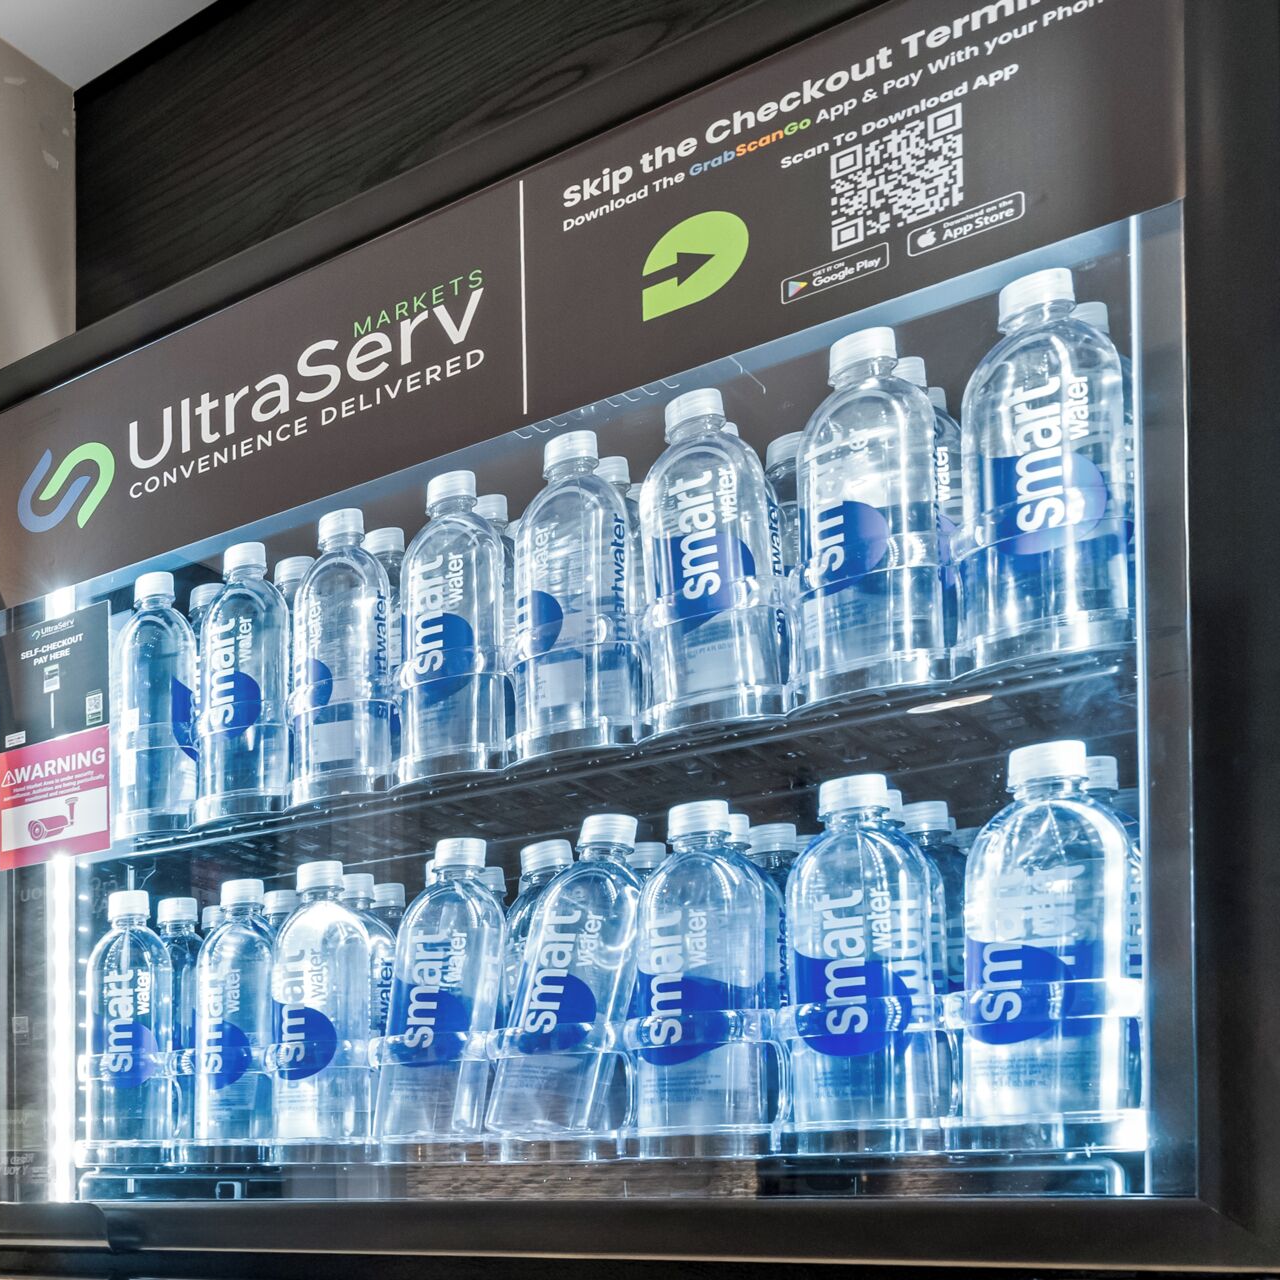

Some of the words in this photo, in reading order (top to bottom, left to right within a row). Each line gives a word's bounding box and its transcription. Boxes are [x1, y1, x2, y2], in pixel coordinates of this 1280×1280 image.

[562, 185, 649, 232] Download
[651, 171, 685, 197] The
[689, 118, 812, 177] GrabScanGo
[815, 98, 858, 124] App
[862, 88, 878, 104] &
[883, 67, 923, 95] Pay
[927, 41, 979, 76] With
[983, 19, 1038, 55] your
[562, 165, 633, 208] Skip
[640, 136, 698, 174] the
[705, 46, 893, 145] Checkout
[780, 142, 829, 169] Scan
[833, 129, 858, 148] To
[861, 81, 968, 137] Download
[972, 63, 1020, 91] App
[812, 266, 855, 288] Google
[856, 256, 881, 275] Play
[942, 224, 973, 242] App
[975, 207, 1015, 231] Store
[353, 269, 484, 338] MARKETS
[128, 287, 484, 469] UltraServ
[129, 415, 308, 499] CONVENIENCE
[320, 349, 485, 426] DELIVERED
[1068, 375, 1089, 442] water
[716, 466, 738, 524] water
[1014, 375, 1064, 534] smart
[447, 551, 464, 603] water
[669, 470, 722, 600] smart
[20, 633, 84, 660] SELF-CHECKOUT
[33, 655, 48, 667] PAY
[49, 648, 71, 663] HERE
[41, 618, 75, 636] UltraServ
[238, 615, 254, 664] water
[410, 554, 443, 676] smart
[210, 618, 236, 728] smart
[14, 747, 106, 783] WARNING
[524, 908, 583, 1035] smart
[689, 908, 708, 967] water
[824, 888, 868, 1036] smart
[871, 886, 891, 954] water
[103, 967, 134, 1073] smart
[136, 969, 151, 1016] water
[282, 948, 306, 1064] smart
[404, 930, 445, 1049] smart
[649, 909, 683, 1046] smart
